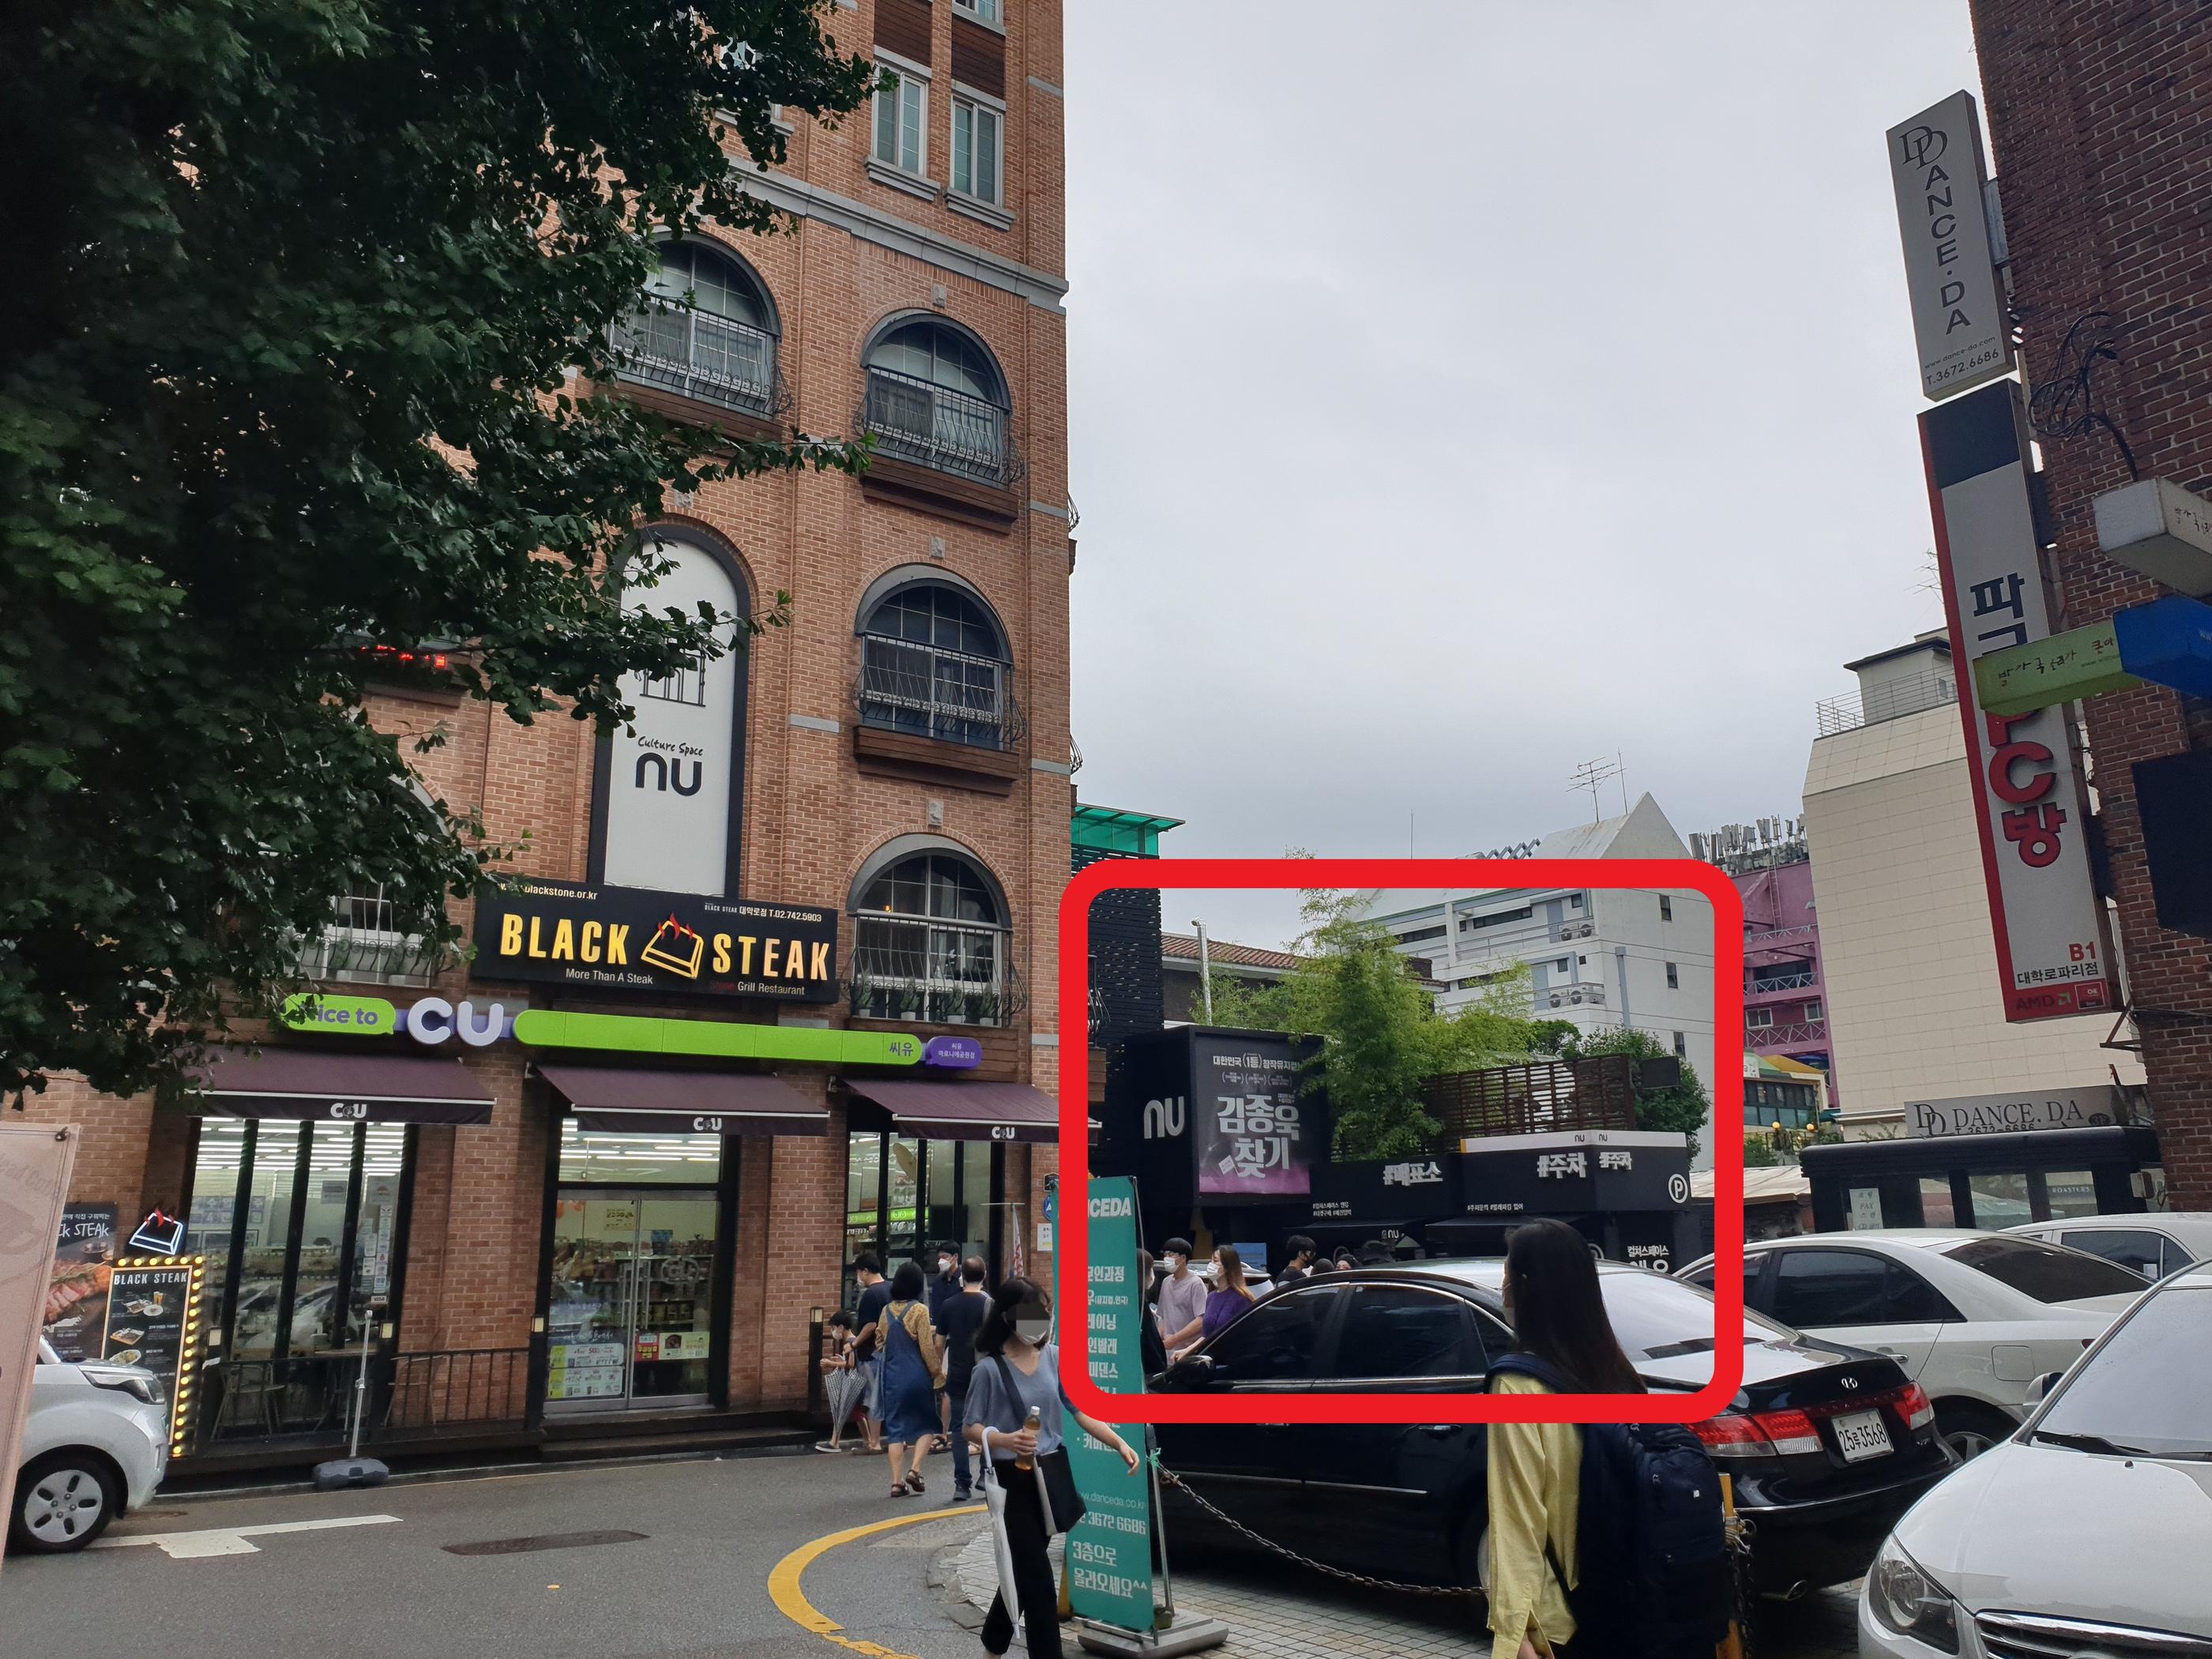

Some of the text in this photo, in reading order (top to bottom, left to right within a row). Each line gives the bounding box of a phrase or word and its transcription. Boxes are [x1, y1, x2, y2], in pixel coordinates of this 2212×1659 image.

[1927, 348, 1999, 386] T.3672.6686
[638, 735, 704, 757] Culture Space
[500, 913, 830, 981] BLACK STEAK
[2069, 941, 2097, 961] B1
[566, 968, 653, 985] More Than A Steak
[2017, 961, 2099, 984] 대학로파리점
[737, 981, 756, 992] Grill
[758, 983, 805, 995] Restaurant
[308, 1003, 378, 1026] ice to
[407, 996, 505, 1047] CU
[890, 1041, 913, 1056] 씨유
[1213, 1055, 1243, 1067] 대한민국
[1217, 1094, 1301, 1142] 김종욱
[2045, 1100, 2084, 1123] DA
[1235, 1137, 1290, 1179] 찾기
[1537, 1152, 1588, 1179] #주차
[1383, 1161, 1444, 1187] #매표소
[114, 1272, 188, 1285] BLACK STEAK
[1088, 1313, 1116, 1330] 레이닝
[1088, 1337, 1117, 1355] 인발레
[1089, 1361, 1119, 1379] 미댄스
[1838, 1424, 1887, 1452] 25루3568
[1088, 1511, 1115, 1529] 3672
[1116, 1517, 1146, 1536] 6686
[1073, 1540, 1118, 1568] 3층으로
